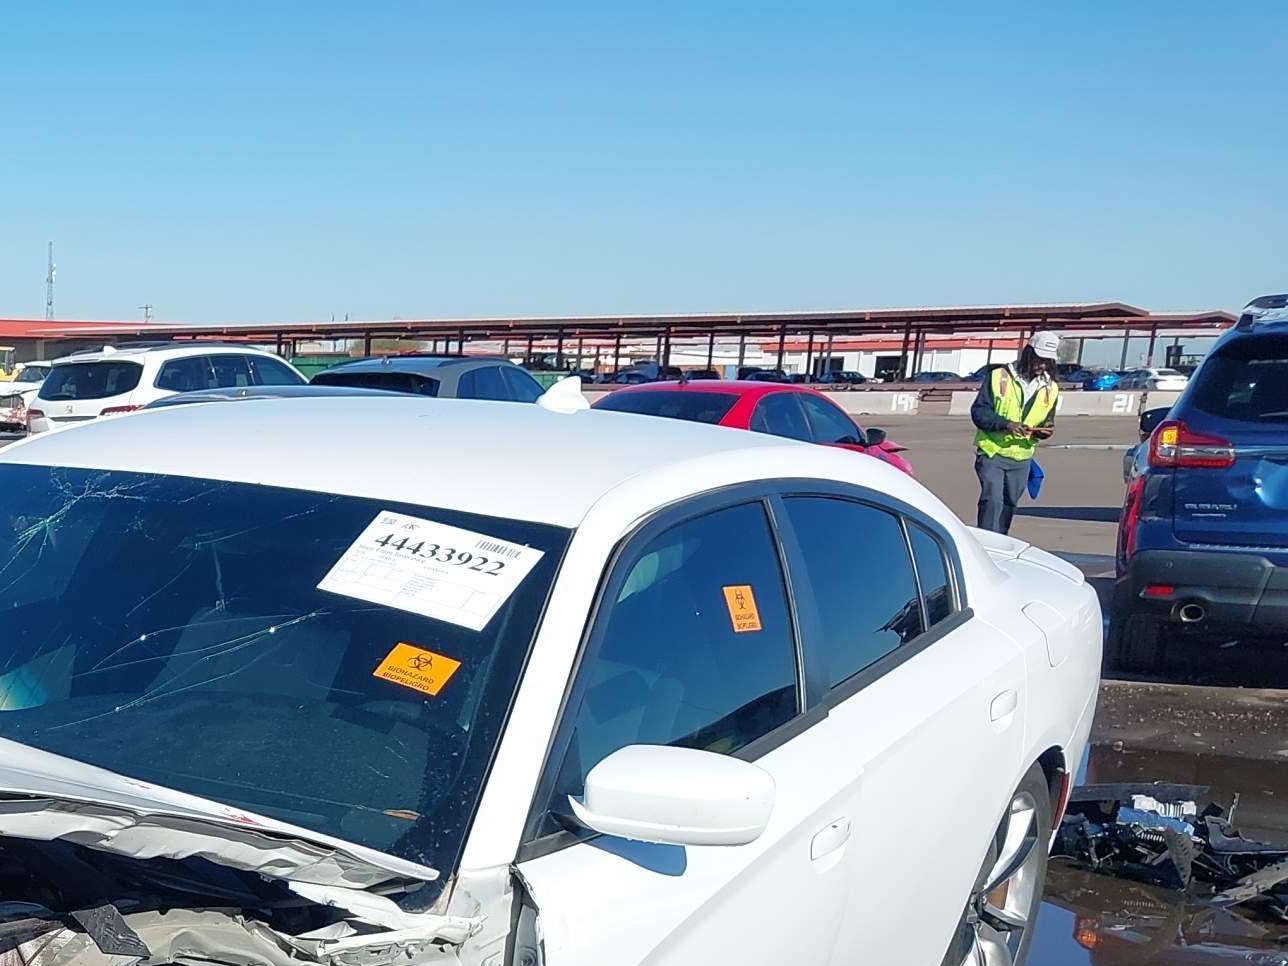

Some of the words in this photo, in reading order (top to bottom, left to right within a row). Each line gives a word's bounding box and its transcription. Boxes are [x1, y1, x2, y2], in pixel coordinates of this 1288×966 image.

[1112, 393, 1134, 413] 21
[375, 533, 506, 577] 44433922
[382, 671, 430, 691] BIOPELIGRO
[387, 665, 435, 685] BIOHAZARD
